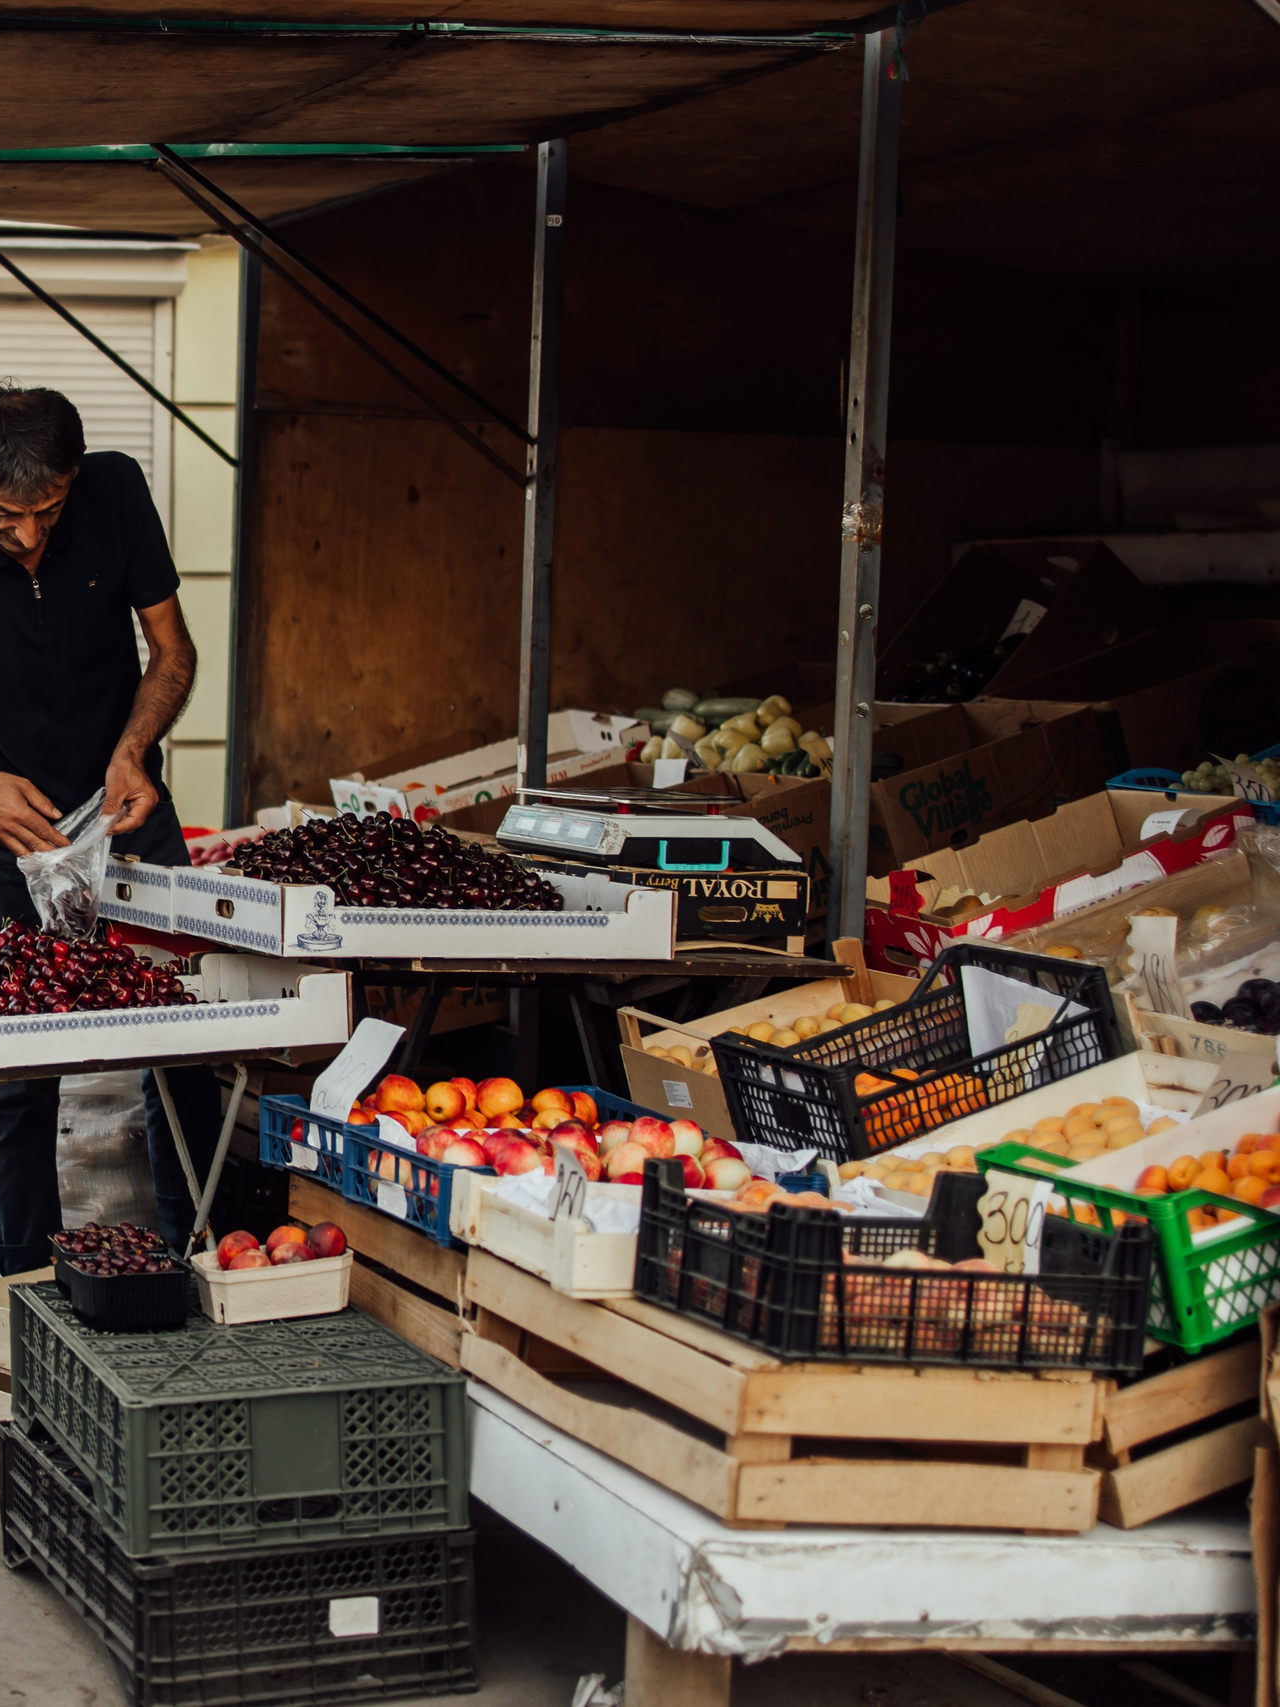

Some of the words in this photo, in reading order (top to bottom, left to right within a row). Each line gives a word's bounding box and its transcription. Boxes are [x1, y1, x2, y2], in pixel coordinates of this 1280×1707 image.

[898, 760, 978, 812] Global
[646, 874, 680, 889] Berry
[683, 877, 763, 899] ROYAL
[984, 1190, 1044, 1248] 300
